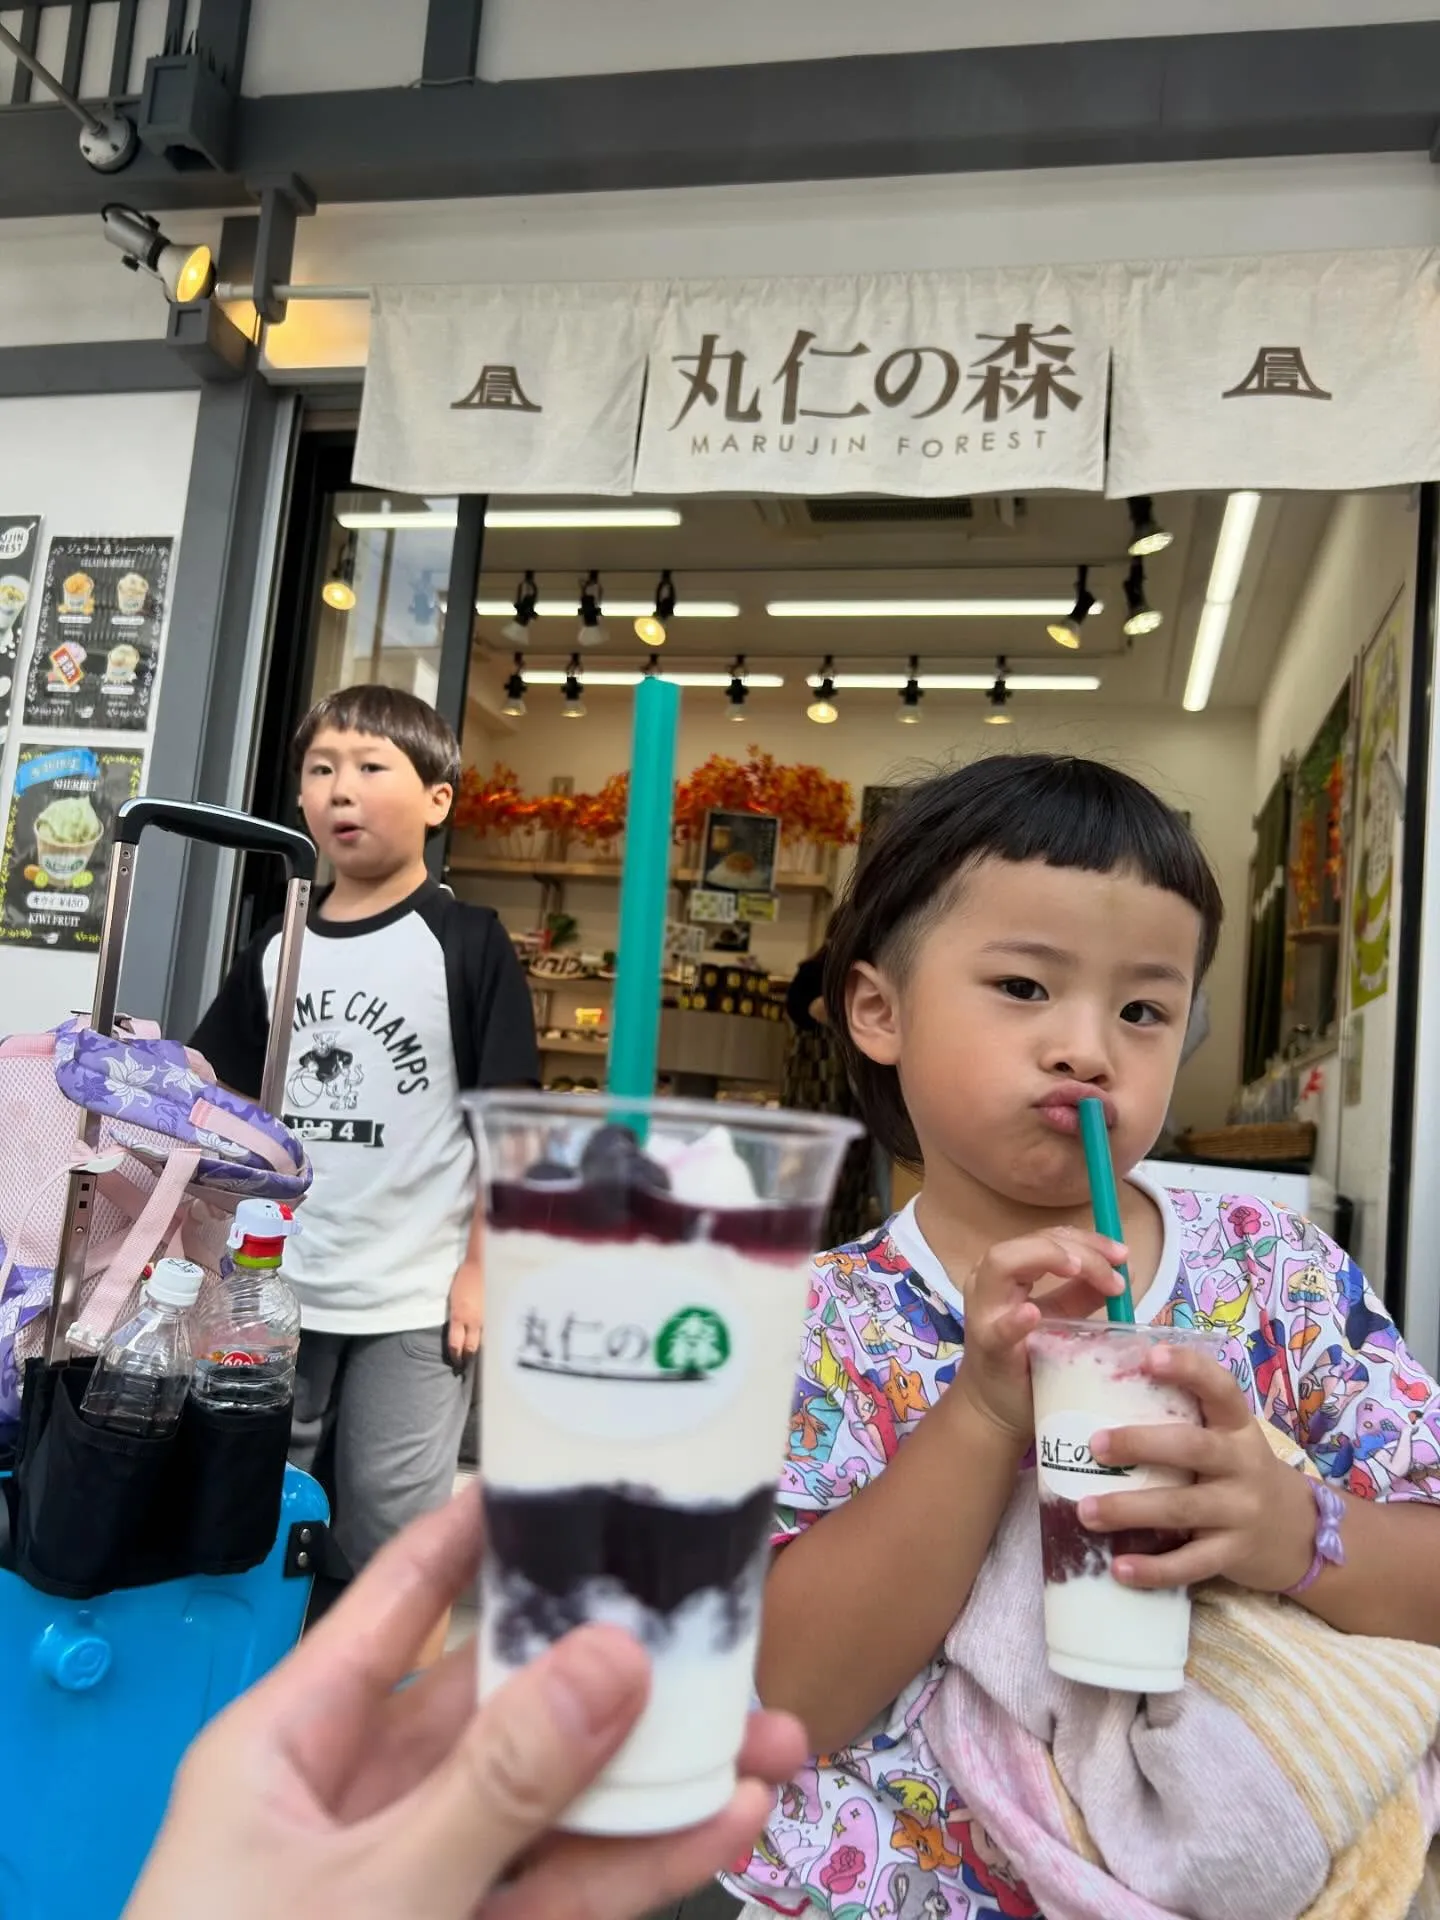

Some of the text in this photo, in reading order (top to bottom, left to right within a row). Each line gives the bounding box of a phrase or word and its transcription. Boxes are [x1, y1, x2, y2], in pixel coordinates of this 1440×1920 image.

[668, 322, 1083, 431] 丸仁の森
[691, 429, 1049, 459] MARUJIN FOREST
[52, 914, 81, 928] FRUIT
[294, 989, 429, 1095] ME CHAMPS
[1040, 1435, 1096, 1465] 丸仁の
